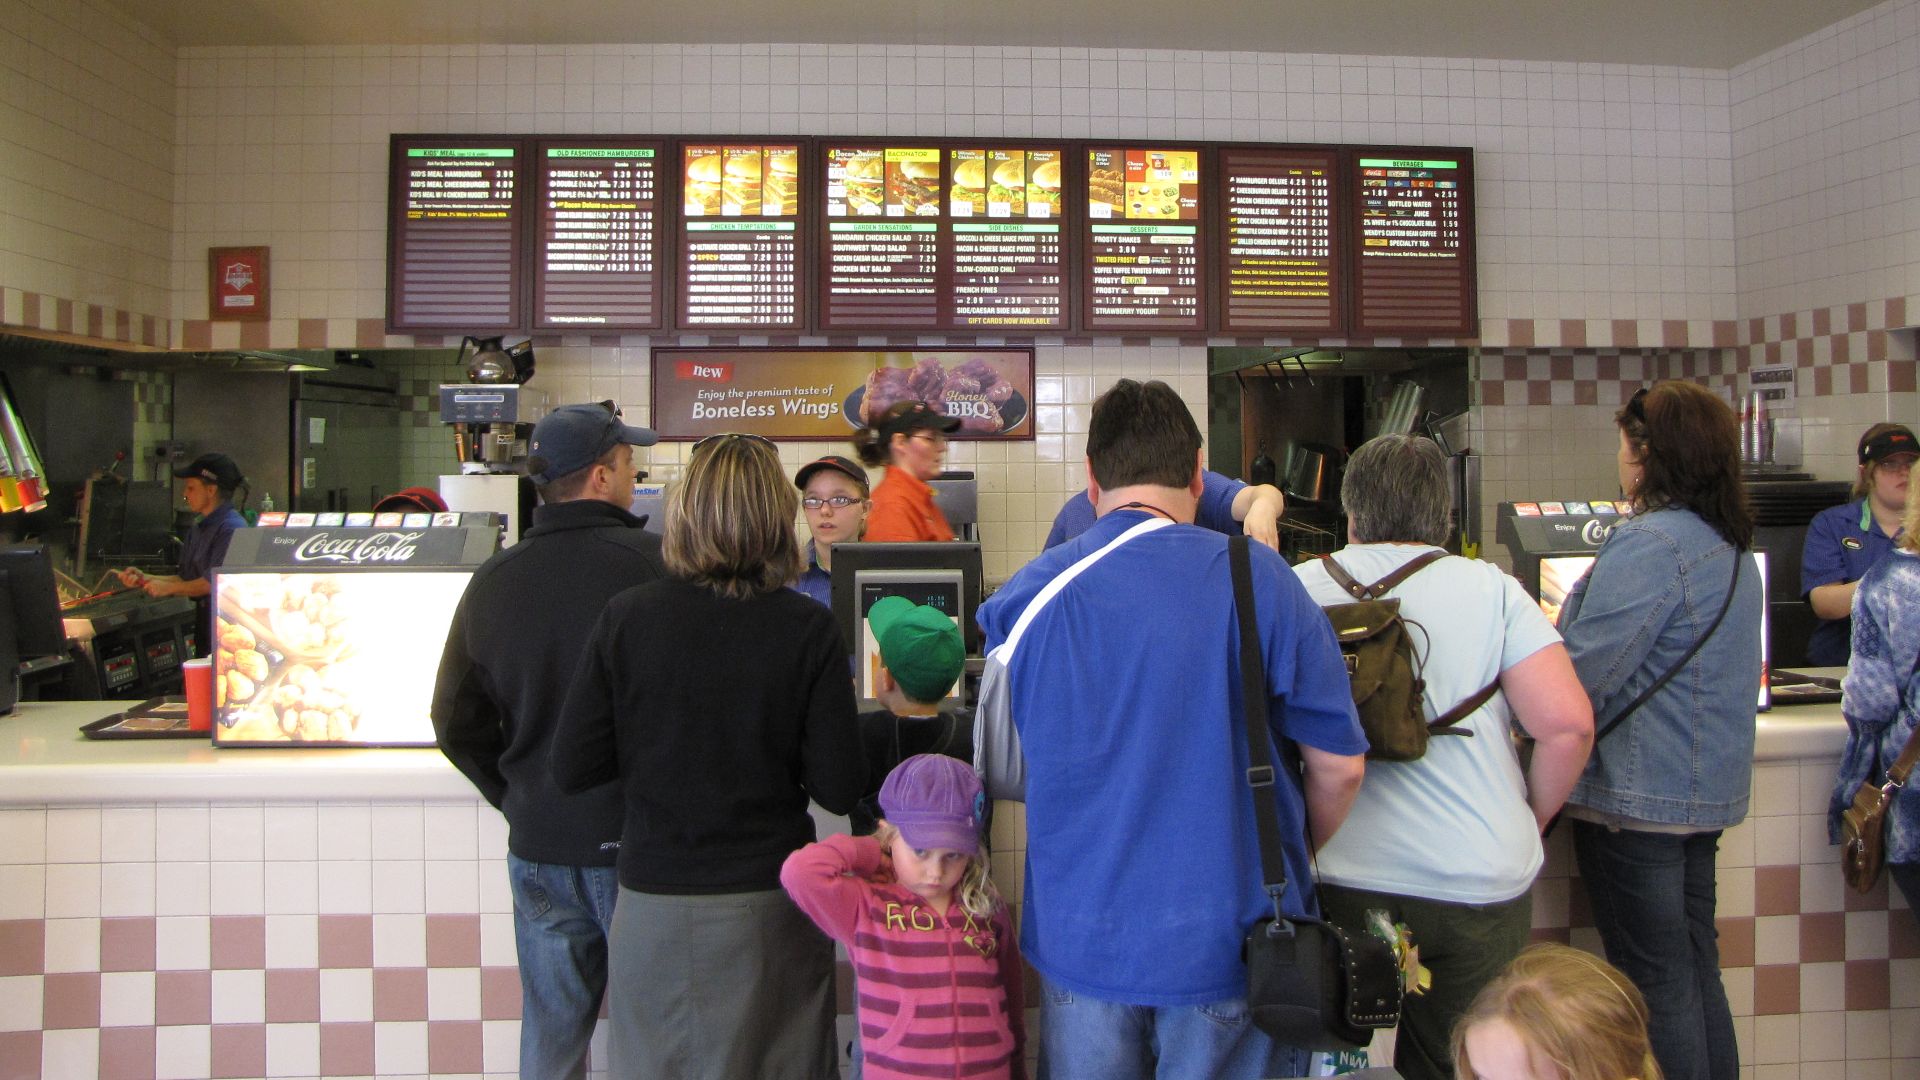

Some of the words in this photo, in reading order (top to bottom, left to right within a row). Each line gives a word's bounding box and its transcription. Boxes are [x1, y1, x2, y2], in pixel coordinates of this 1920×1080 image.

[693, 364, 723, 378] new
[698, 388, 726, 400] Enjoy
[728, 387, 745, 397] the
[746, 387, 791, 400] premium
[794, 386, 818, 395] taste
[822, 384, 834, 397] of
[946, 390, 988, 403] Honey
[692, 401, 776, 419] Boneless
[782, 398, 839, 419] Wings
[946, 402, 992, 419] BBQ
[273, 537, 297, 545] Enjoy
[294, 532, 426, 561] Coca-Cola
